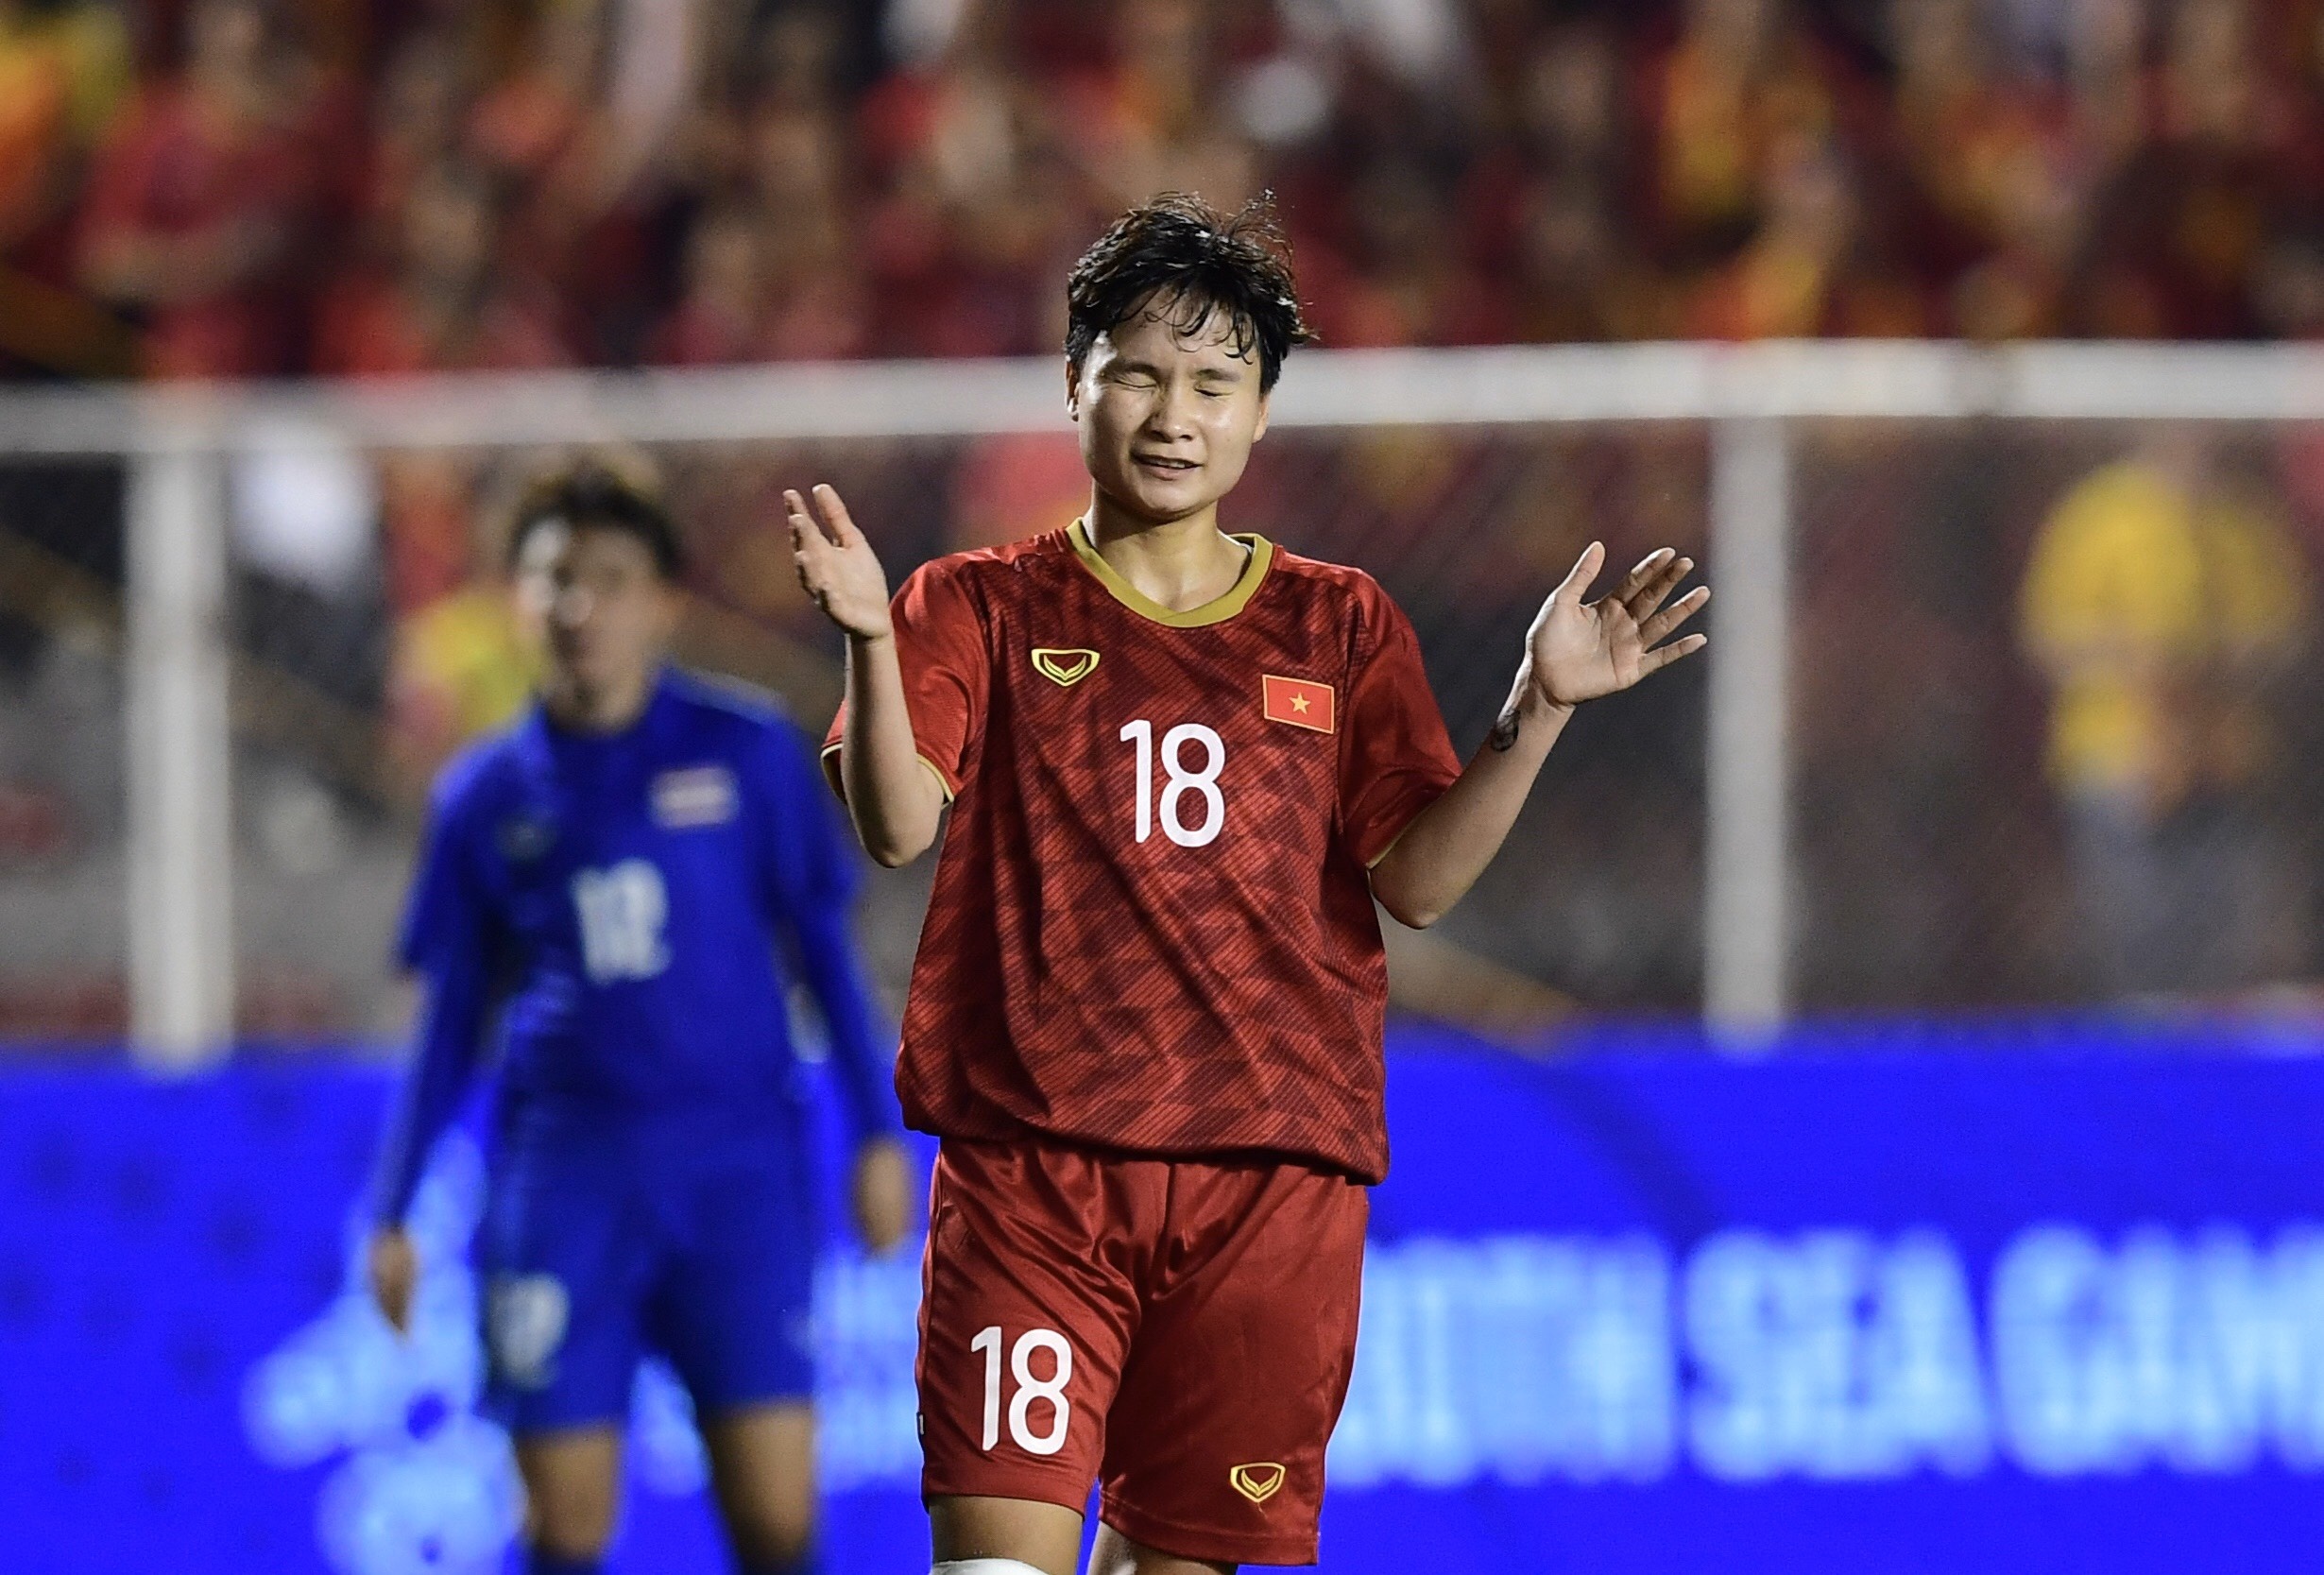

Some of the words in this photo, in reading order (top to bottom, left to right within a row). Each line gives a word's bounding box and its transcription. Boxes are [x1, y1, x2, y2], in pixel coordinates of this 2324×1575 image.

[1119, 719, 1226, 848] 18
[970, 1326, 1073, 1455] 18
[1687, 1226, 1991, 1480] SEA
